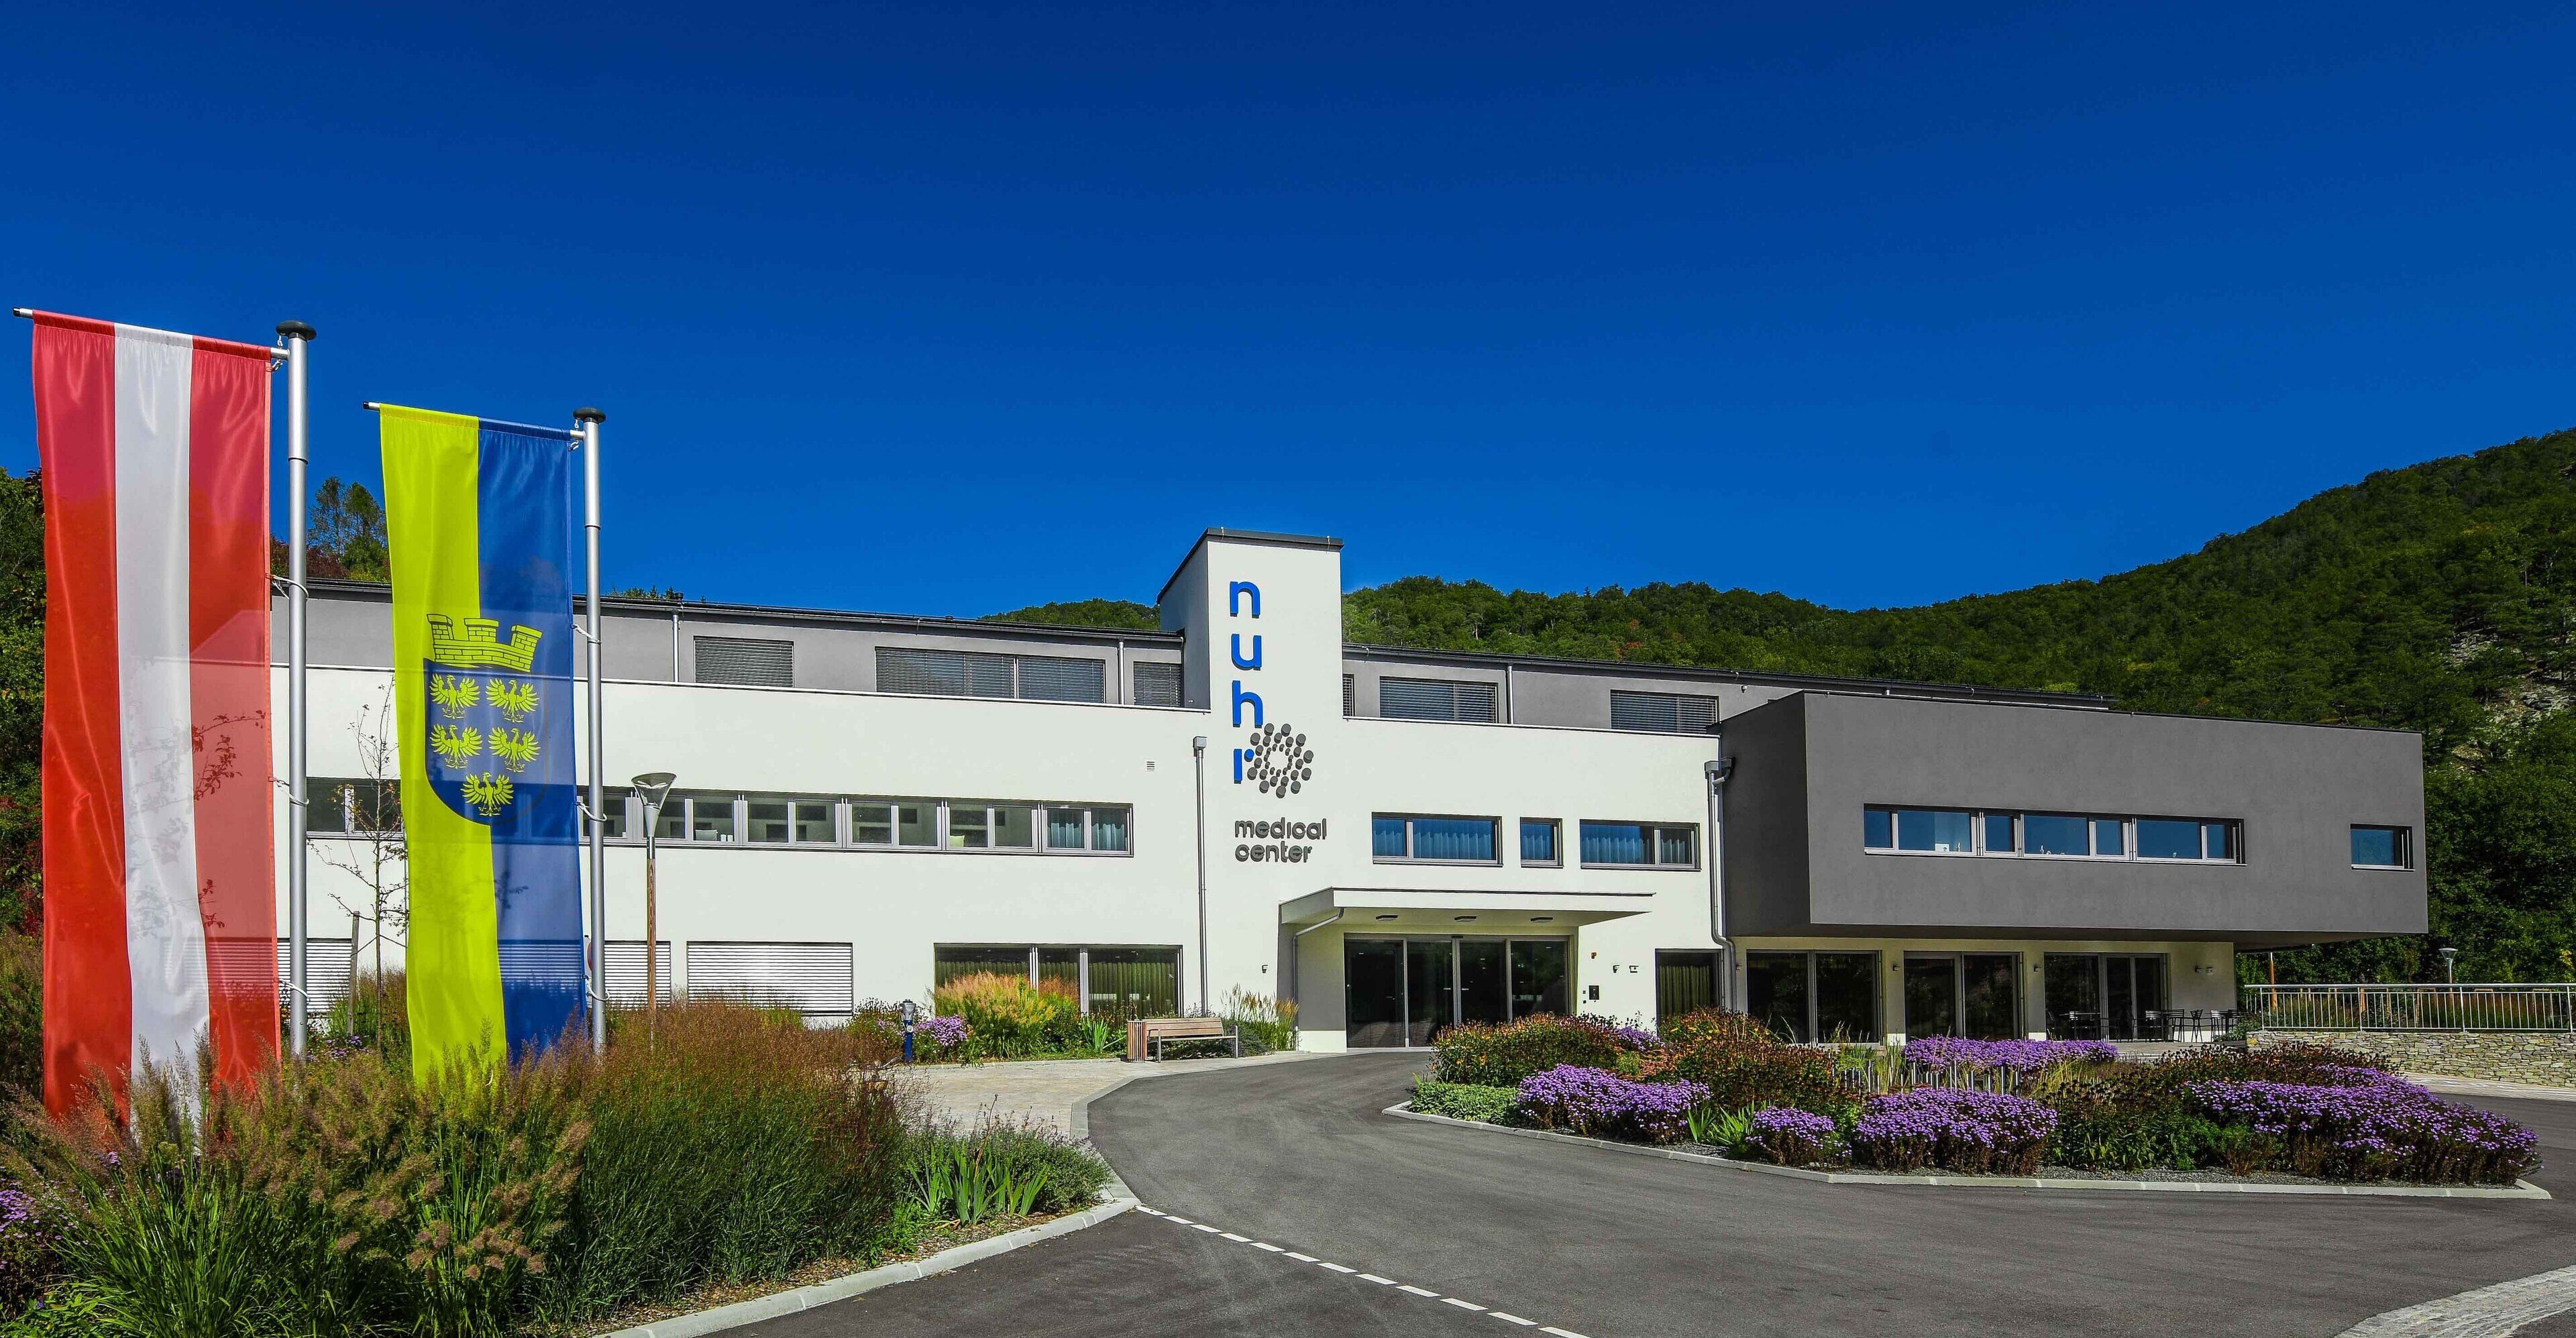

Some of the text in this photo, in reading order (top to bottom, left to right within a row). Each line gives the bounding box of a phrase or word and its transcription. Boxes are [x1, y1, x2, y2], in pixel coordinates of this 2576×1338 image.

[1230, 581, 1263, 784] nuhr
[1235, 817, 1327, 840] medical
[1235, 840, 1313, 863] center
